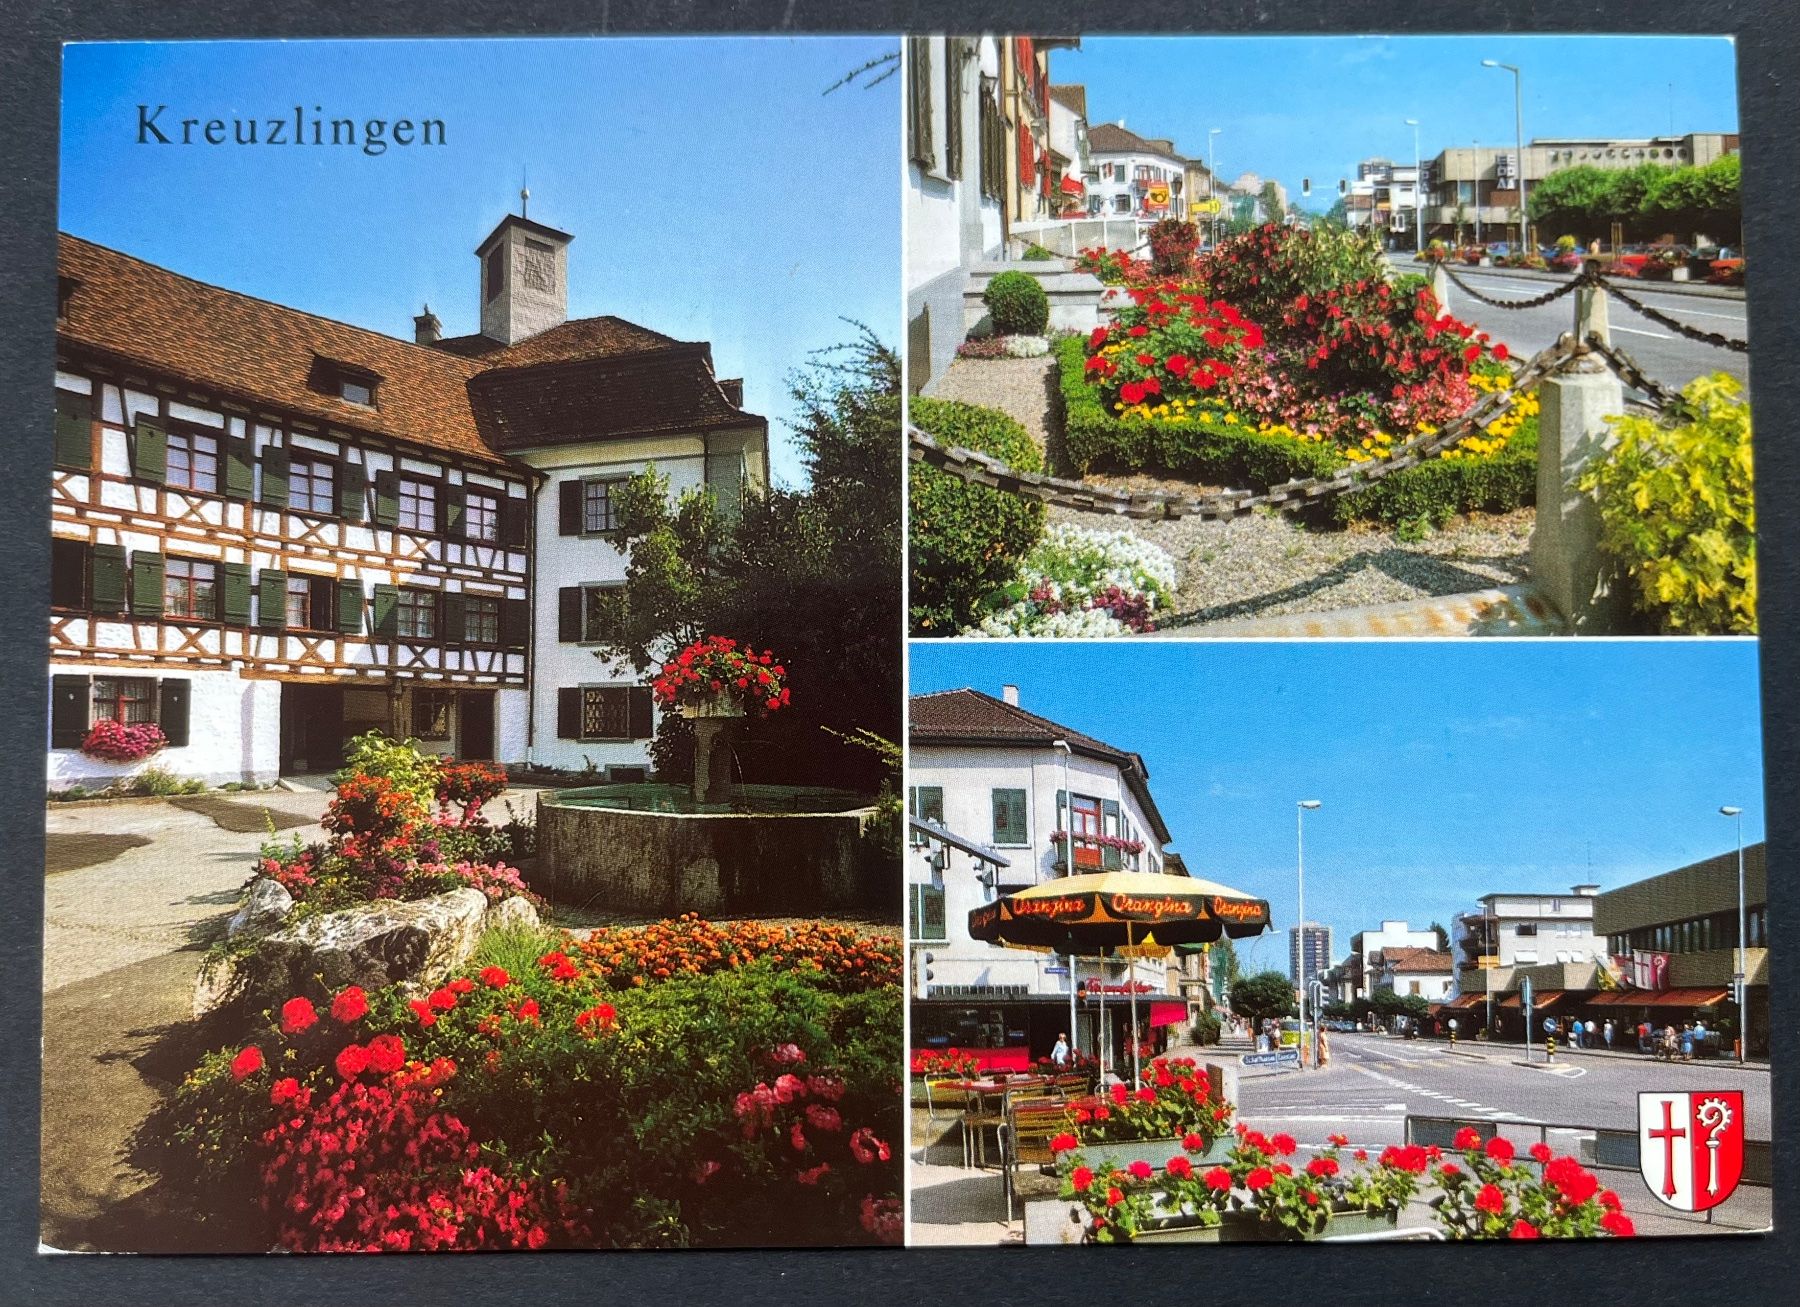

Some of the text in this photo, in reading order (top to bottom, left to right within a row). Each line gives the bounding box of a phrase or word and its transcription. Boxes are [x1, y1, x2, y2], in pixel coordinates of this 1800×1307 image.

[137, 104, 448, 157] Kreuzlingen
[1112, 892, 1193, 918] Orangina
[1213, 897, 1262, 921] Orangina
